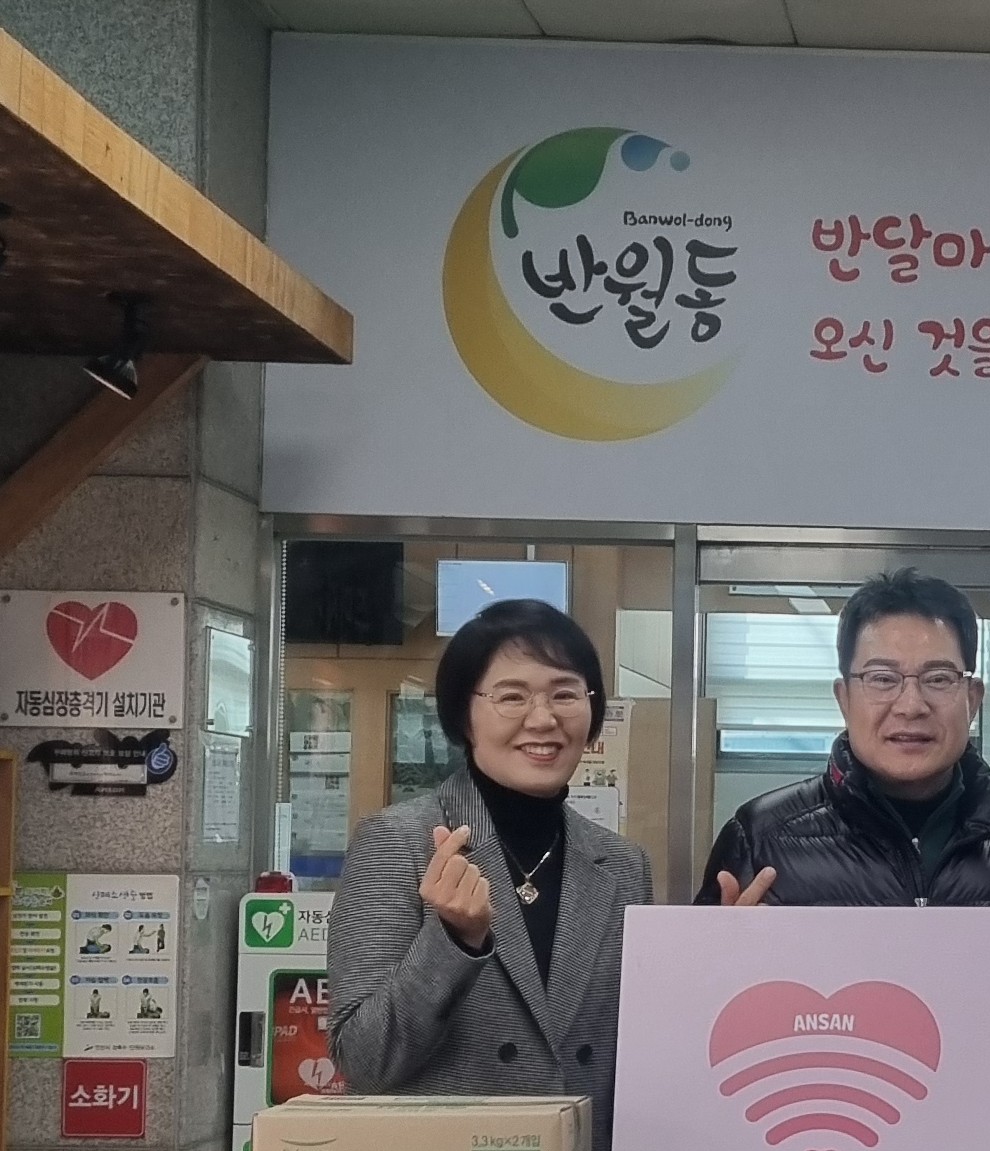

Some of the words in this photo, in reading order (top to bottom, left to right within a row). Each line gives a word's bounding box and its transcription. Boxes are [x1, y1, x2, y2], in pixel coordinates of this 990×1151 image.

[623, 210, 733, 231] Banwol-dong
[522, 234, 738, 349] 반월동
[809, 318, 894, 373] 오신
[15, 691, 108, 717] 자동심장충격기
[112, 692, 166, 718] 설치기관
[289, 978, 329, 1004] AE
[793, 1013, 854, 1032] ANSAN
[68, 1082, 138, 1110] 소화기
